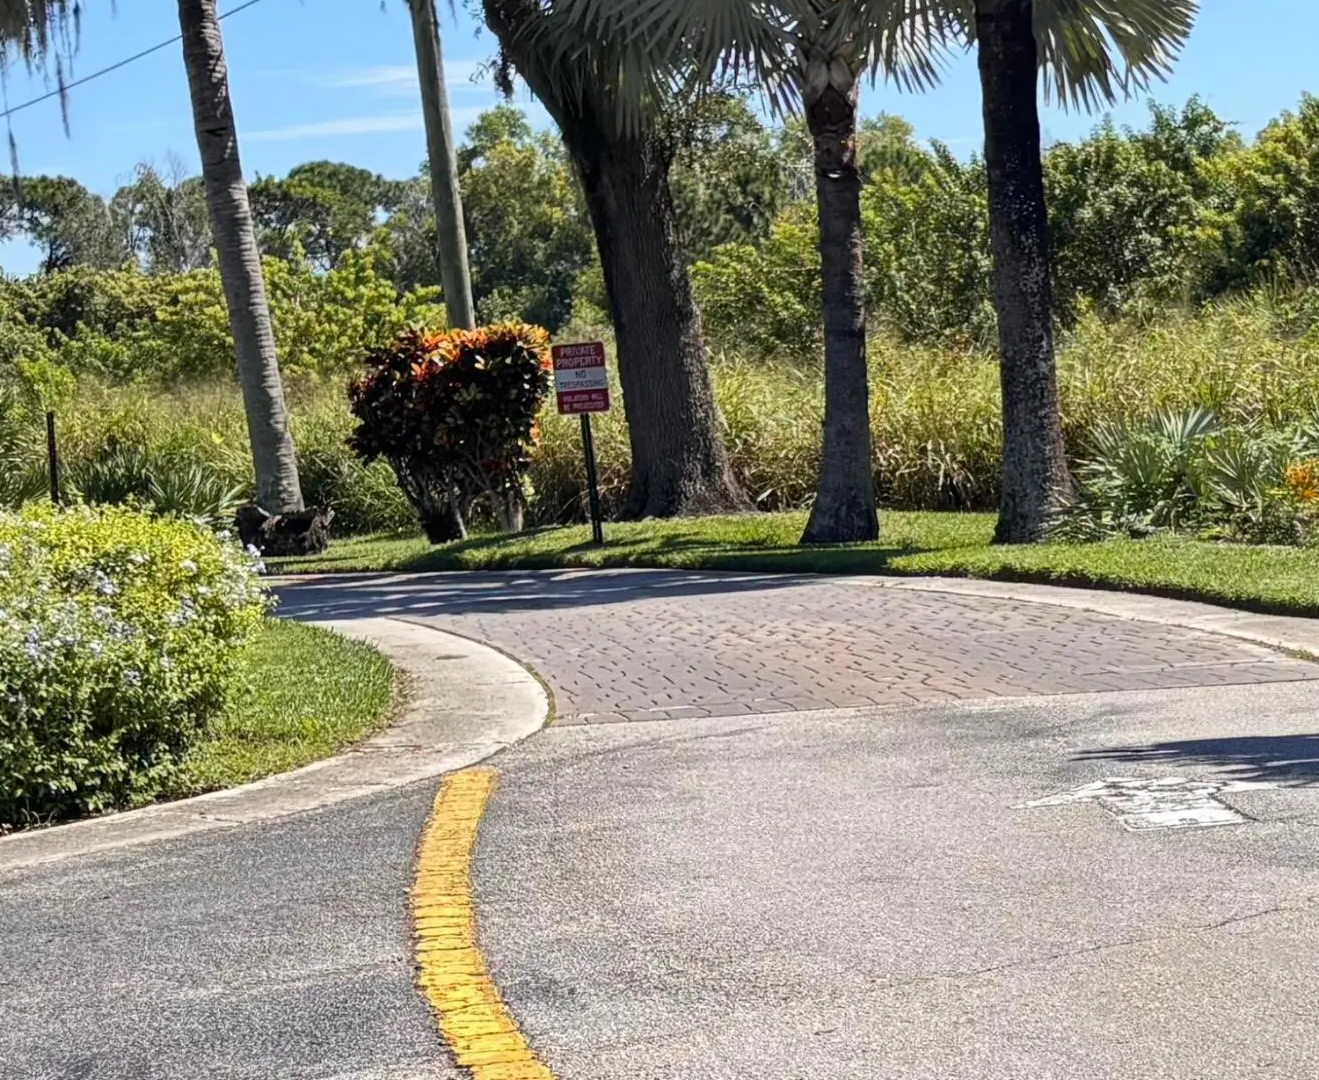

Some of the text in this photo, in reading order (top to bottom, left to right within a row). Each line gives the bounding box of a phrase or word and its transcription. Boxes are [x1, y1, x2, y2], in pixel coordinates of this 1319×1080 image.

[560, 345, 596, 357] PRIVATE
[556, 356, 602, 368] PROPERTY
[575, 370, 587, 379] NO
